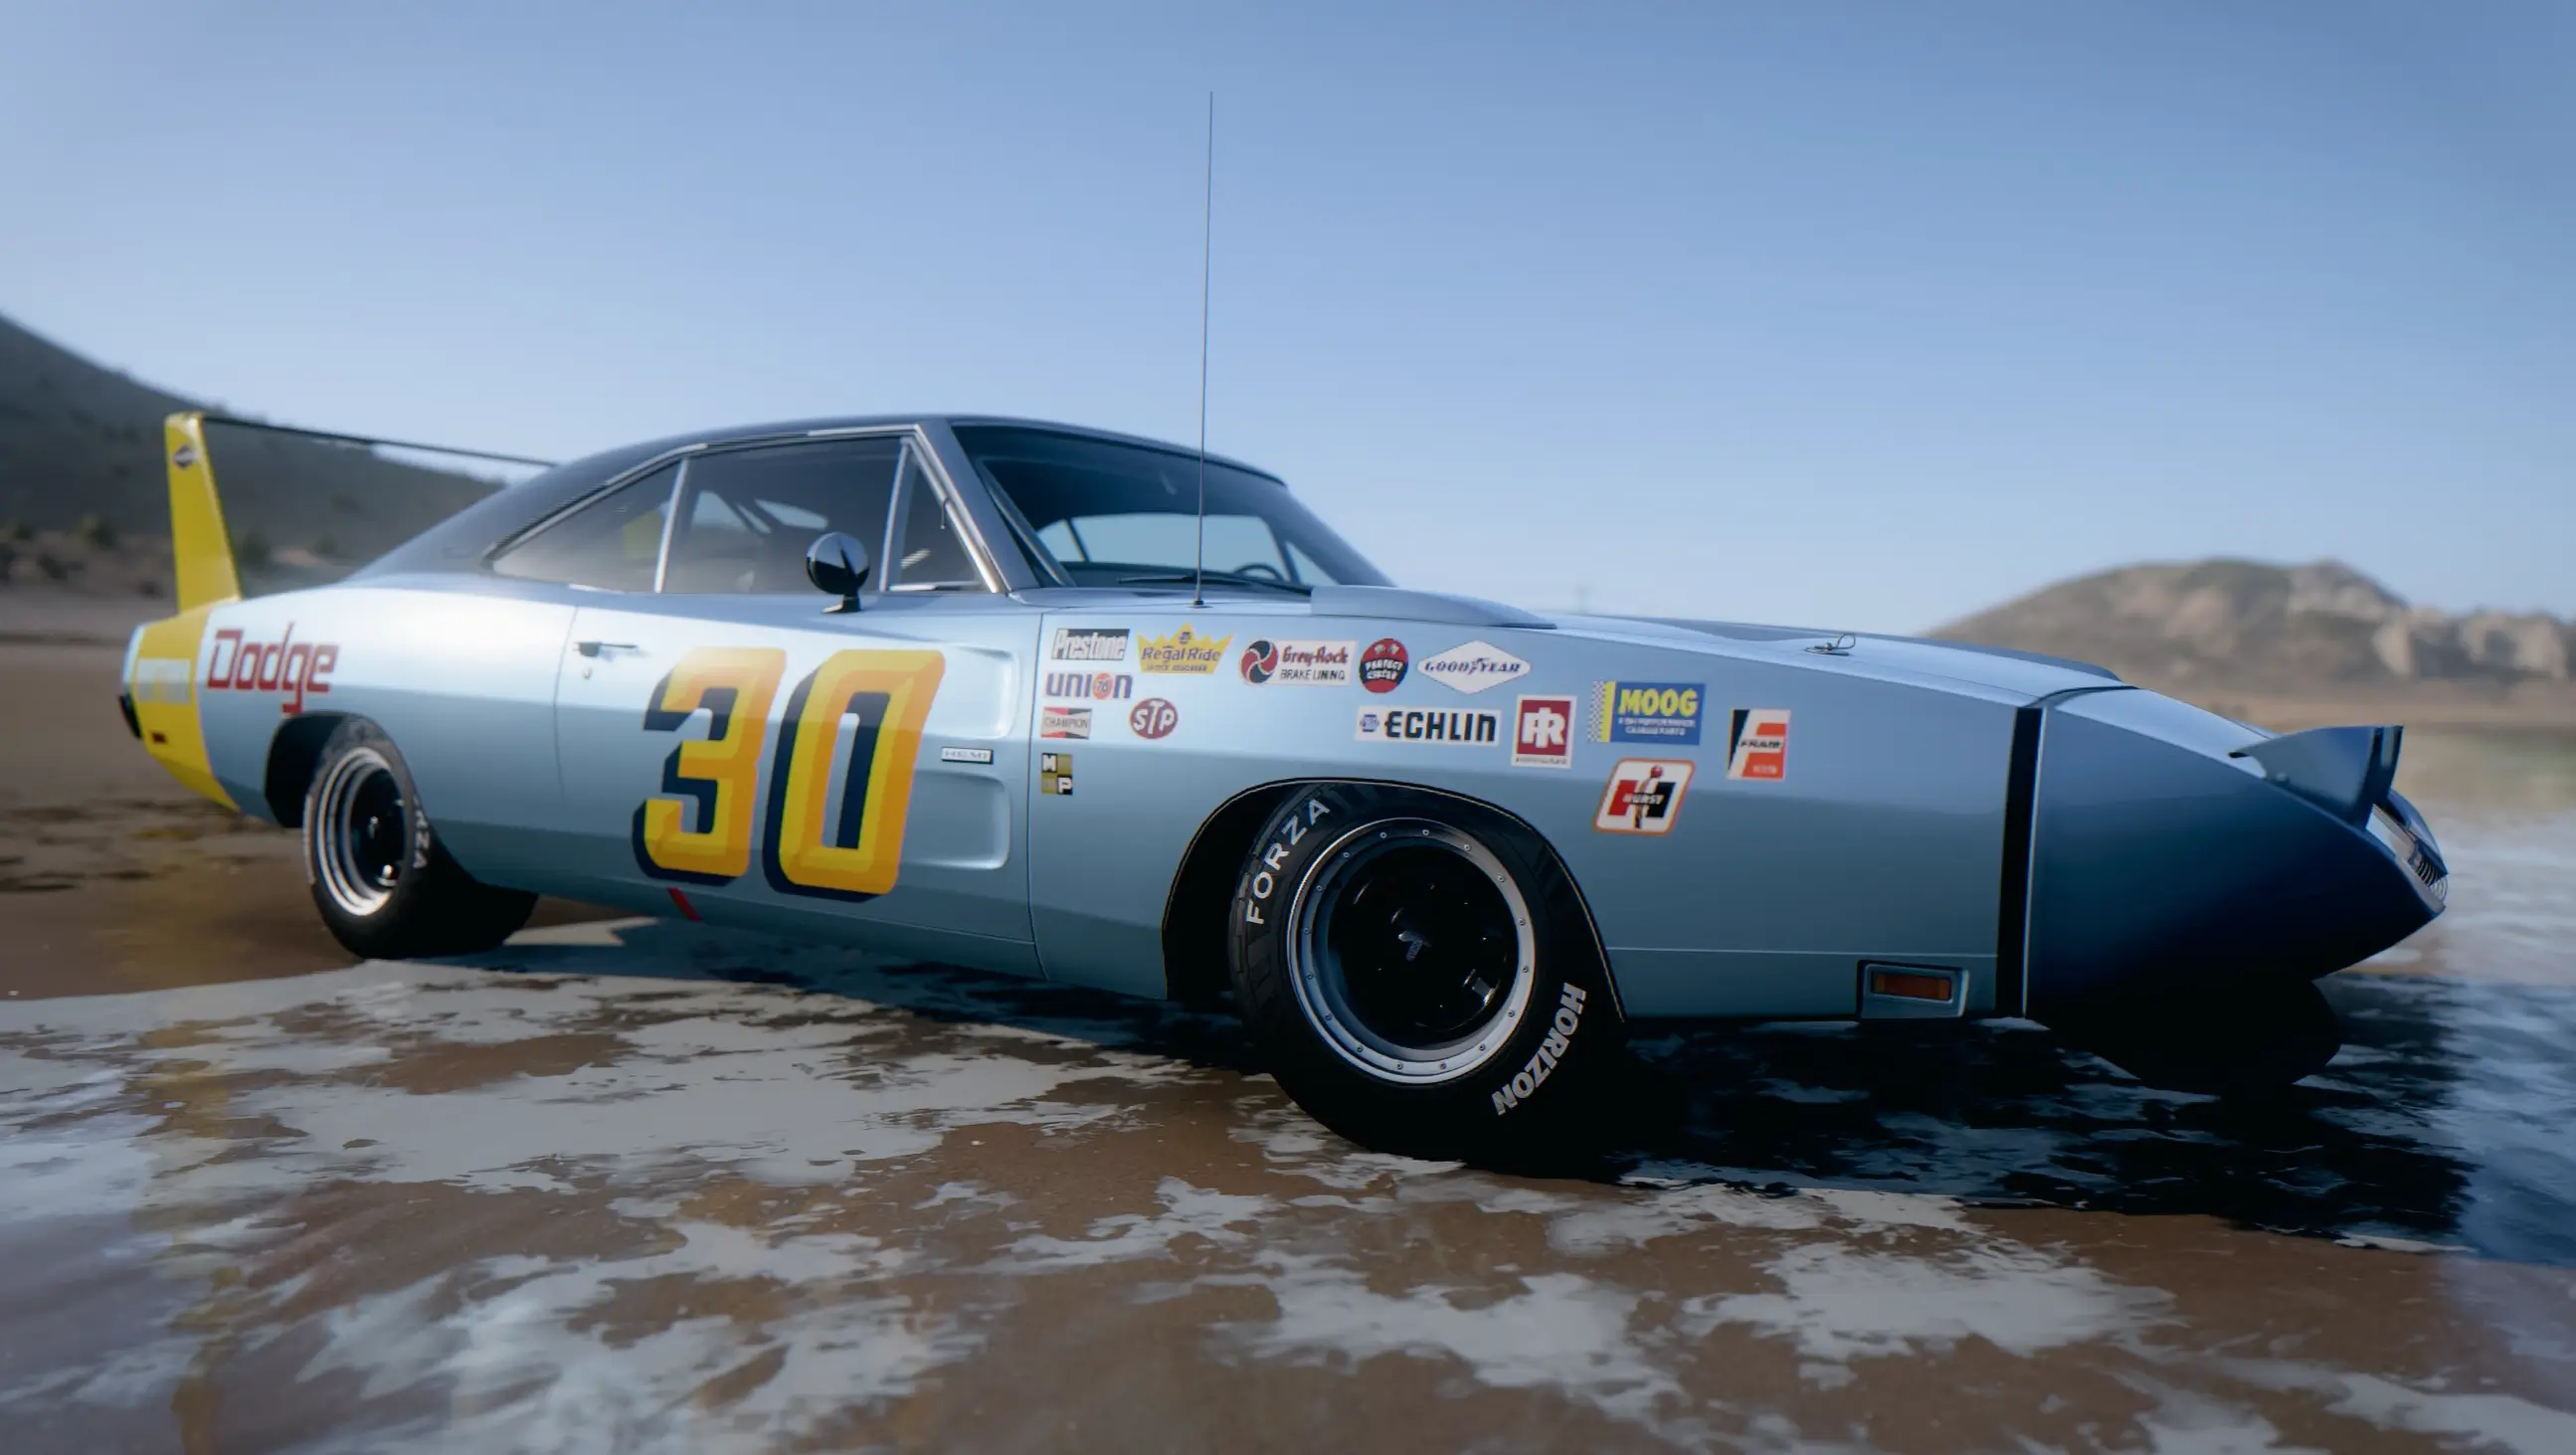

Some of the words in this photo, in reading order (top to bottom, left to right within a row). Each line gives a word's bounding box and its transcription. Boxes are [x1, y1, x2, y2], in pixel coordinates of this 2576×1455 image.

[1052, 629, 1127, 660] Prestone
[1141, 646, 1185, 663] Regal
[1188, 646, 1221, 662] Ride
[207, 623, 339, 716] Dodge
[1280, 668, 1312, 681] BRAKE
[1313, 669, 1346, 681] LINING
[1424, 657, 1521, 675] GOODYEAR
[1132, 699, 1176, 735] STP
[1617, 687, 1698, 717] MOOG
[1044, 716, 1088, 729] CHAMPION
[1383, 710, 1497, 742] ECHLIN
[632, 647, 946, 903] 30
[1246, 799, 1332, 925] FORZA
[1492, 982, 1587, 1116] HORIZON
